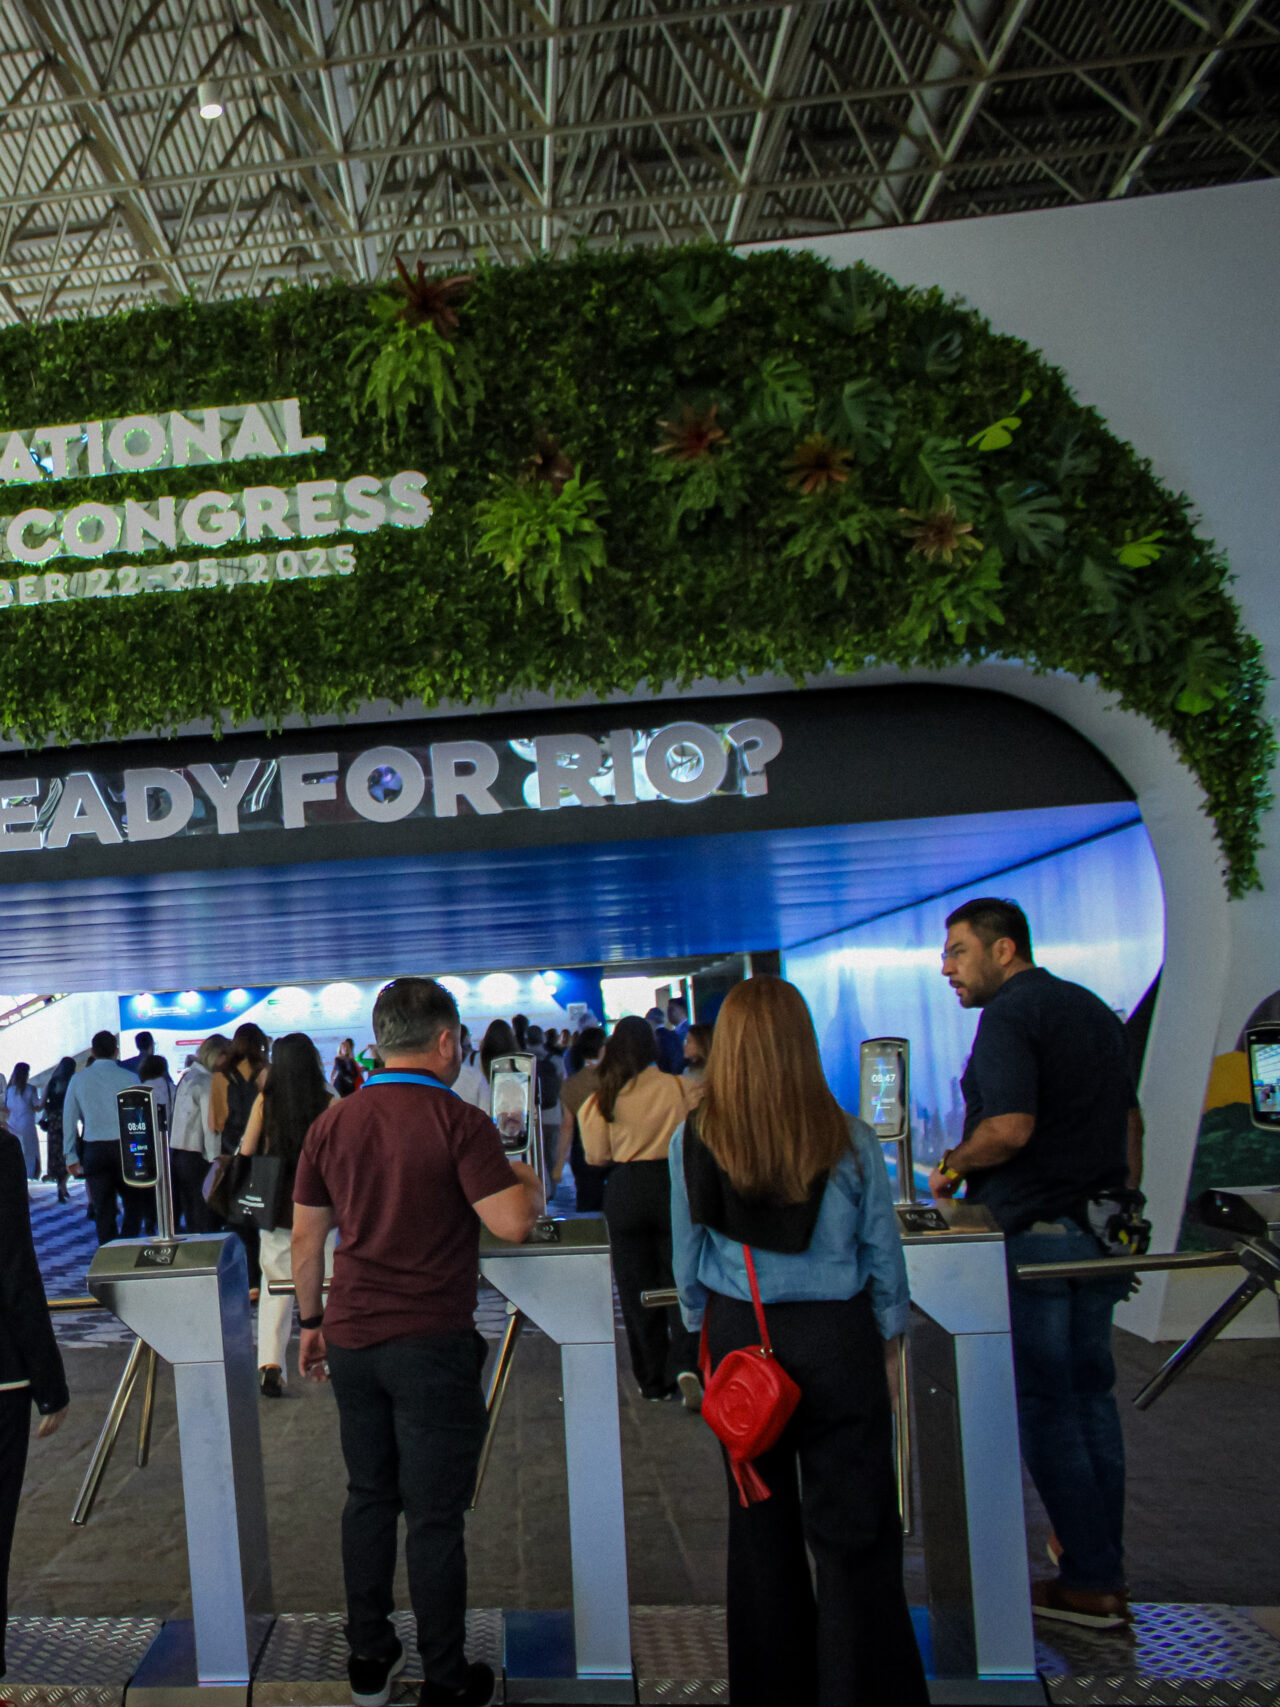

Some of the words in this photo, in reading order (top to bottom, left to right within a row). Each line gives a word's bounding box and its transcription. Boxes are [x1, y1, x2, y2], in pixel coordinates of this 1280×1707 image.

[6, 470, 433, 565] CONGRESS
[251, 545, 357, 583] 2025
[278, 740, 503, 829] FOR
[535, 718, 782, 811] RIO?
